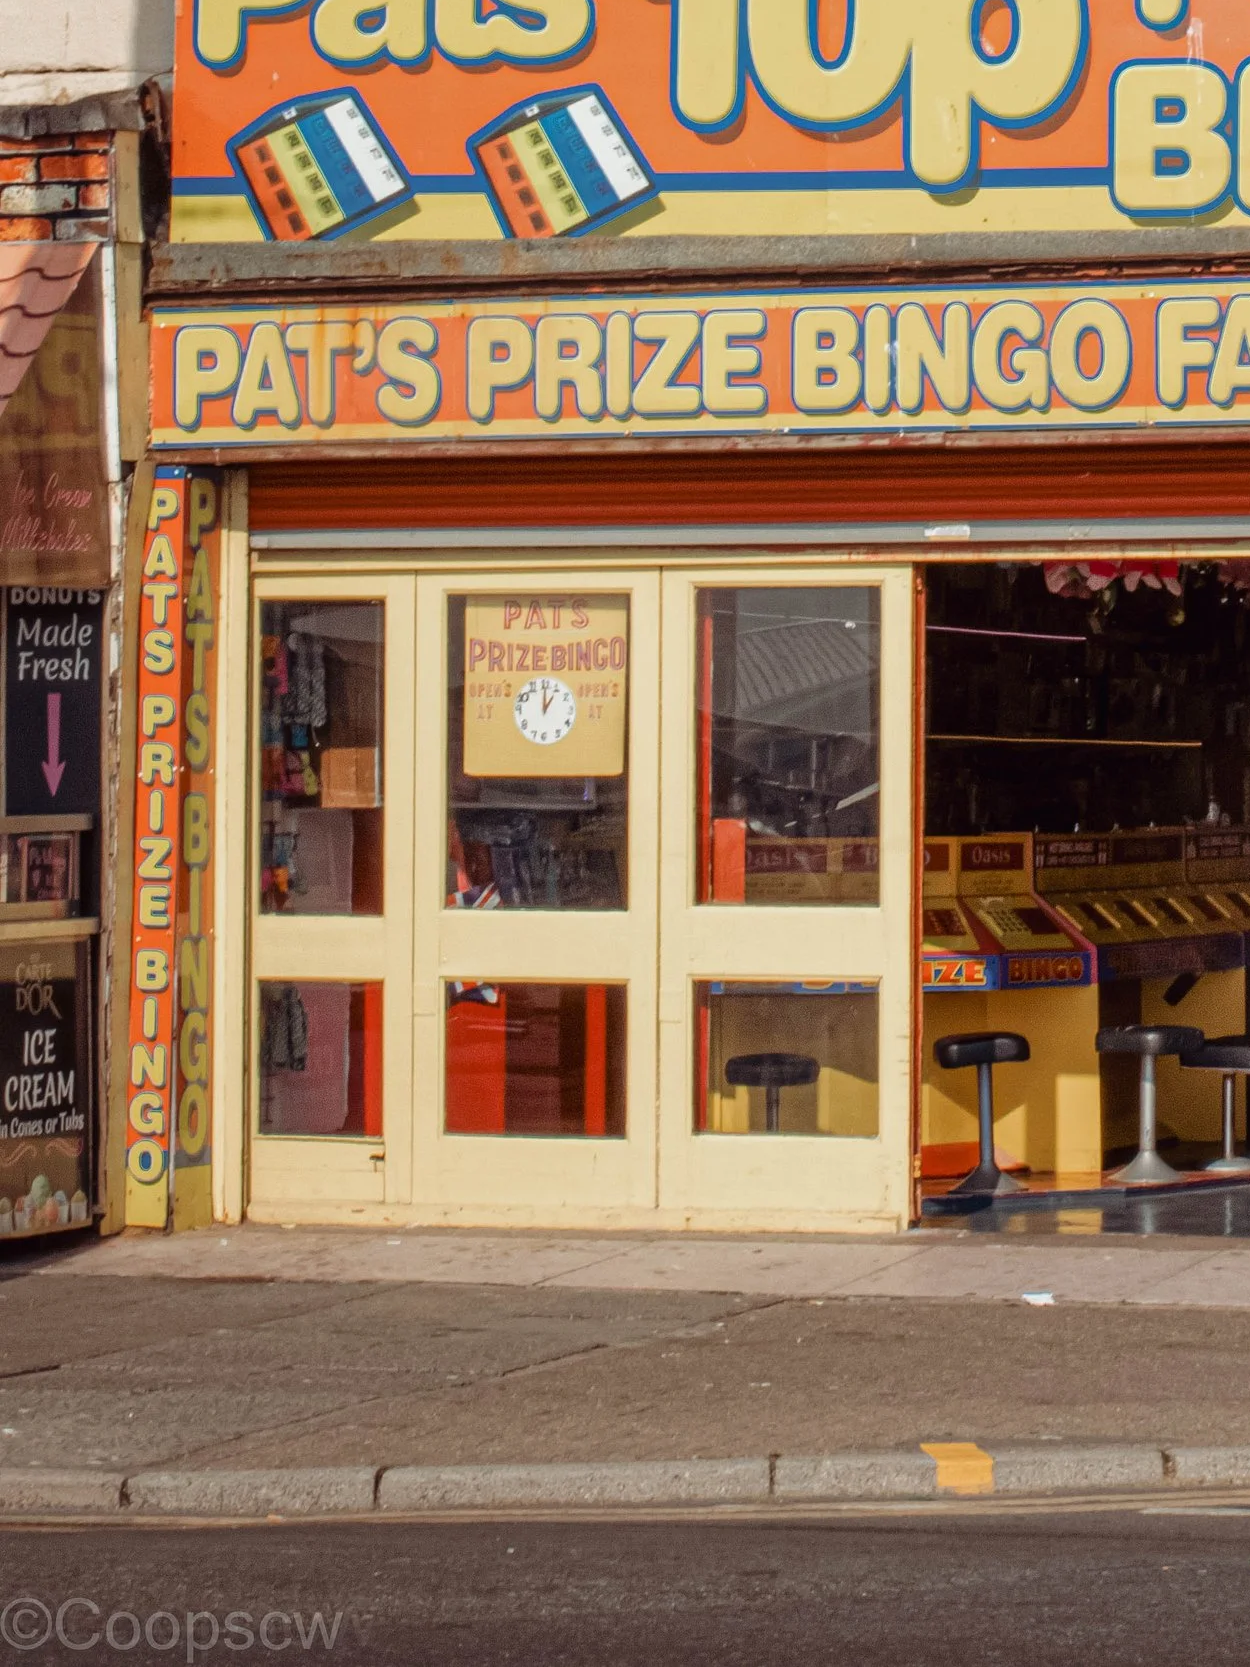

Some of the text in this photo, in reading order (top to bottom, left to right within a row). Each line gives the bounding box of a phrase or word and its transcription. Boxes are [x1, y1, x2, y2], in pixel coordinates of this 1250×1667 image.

[172, 316, 442, 432] PAT'S
[466, 306, 769, 425] PRIZE
[790, 298, 1134, 419] BINGO
[16, 612, 93, 648] Made
[503, 598, 590, 630] PATS
[17, 647, 91, 682] Fresh
[551, 636, 628, 672] BINGO
[179, 478, 217, 1156] PATS BINGO
[127, 488, 180, 1184] PATS PRIZE BINGO
[1007, 956, 1084, 984] BINGO
[23, 1028, 57, 1067] ICE
[4, 1070, 75, 1112] CREAM
[10, 1116, 43, 1138] Cones
[45, 1117, 58, 1134] or
[59, 1107, 85, 1132] Tubs
